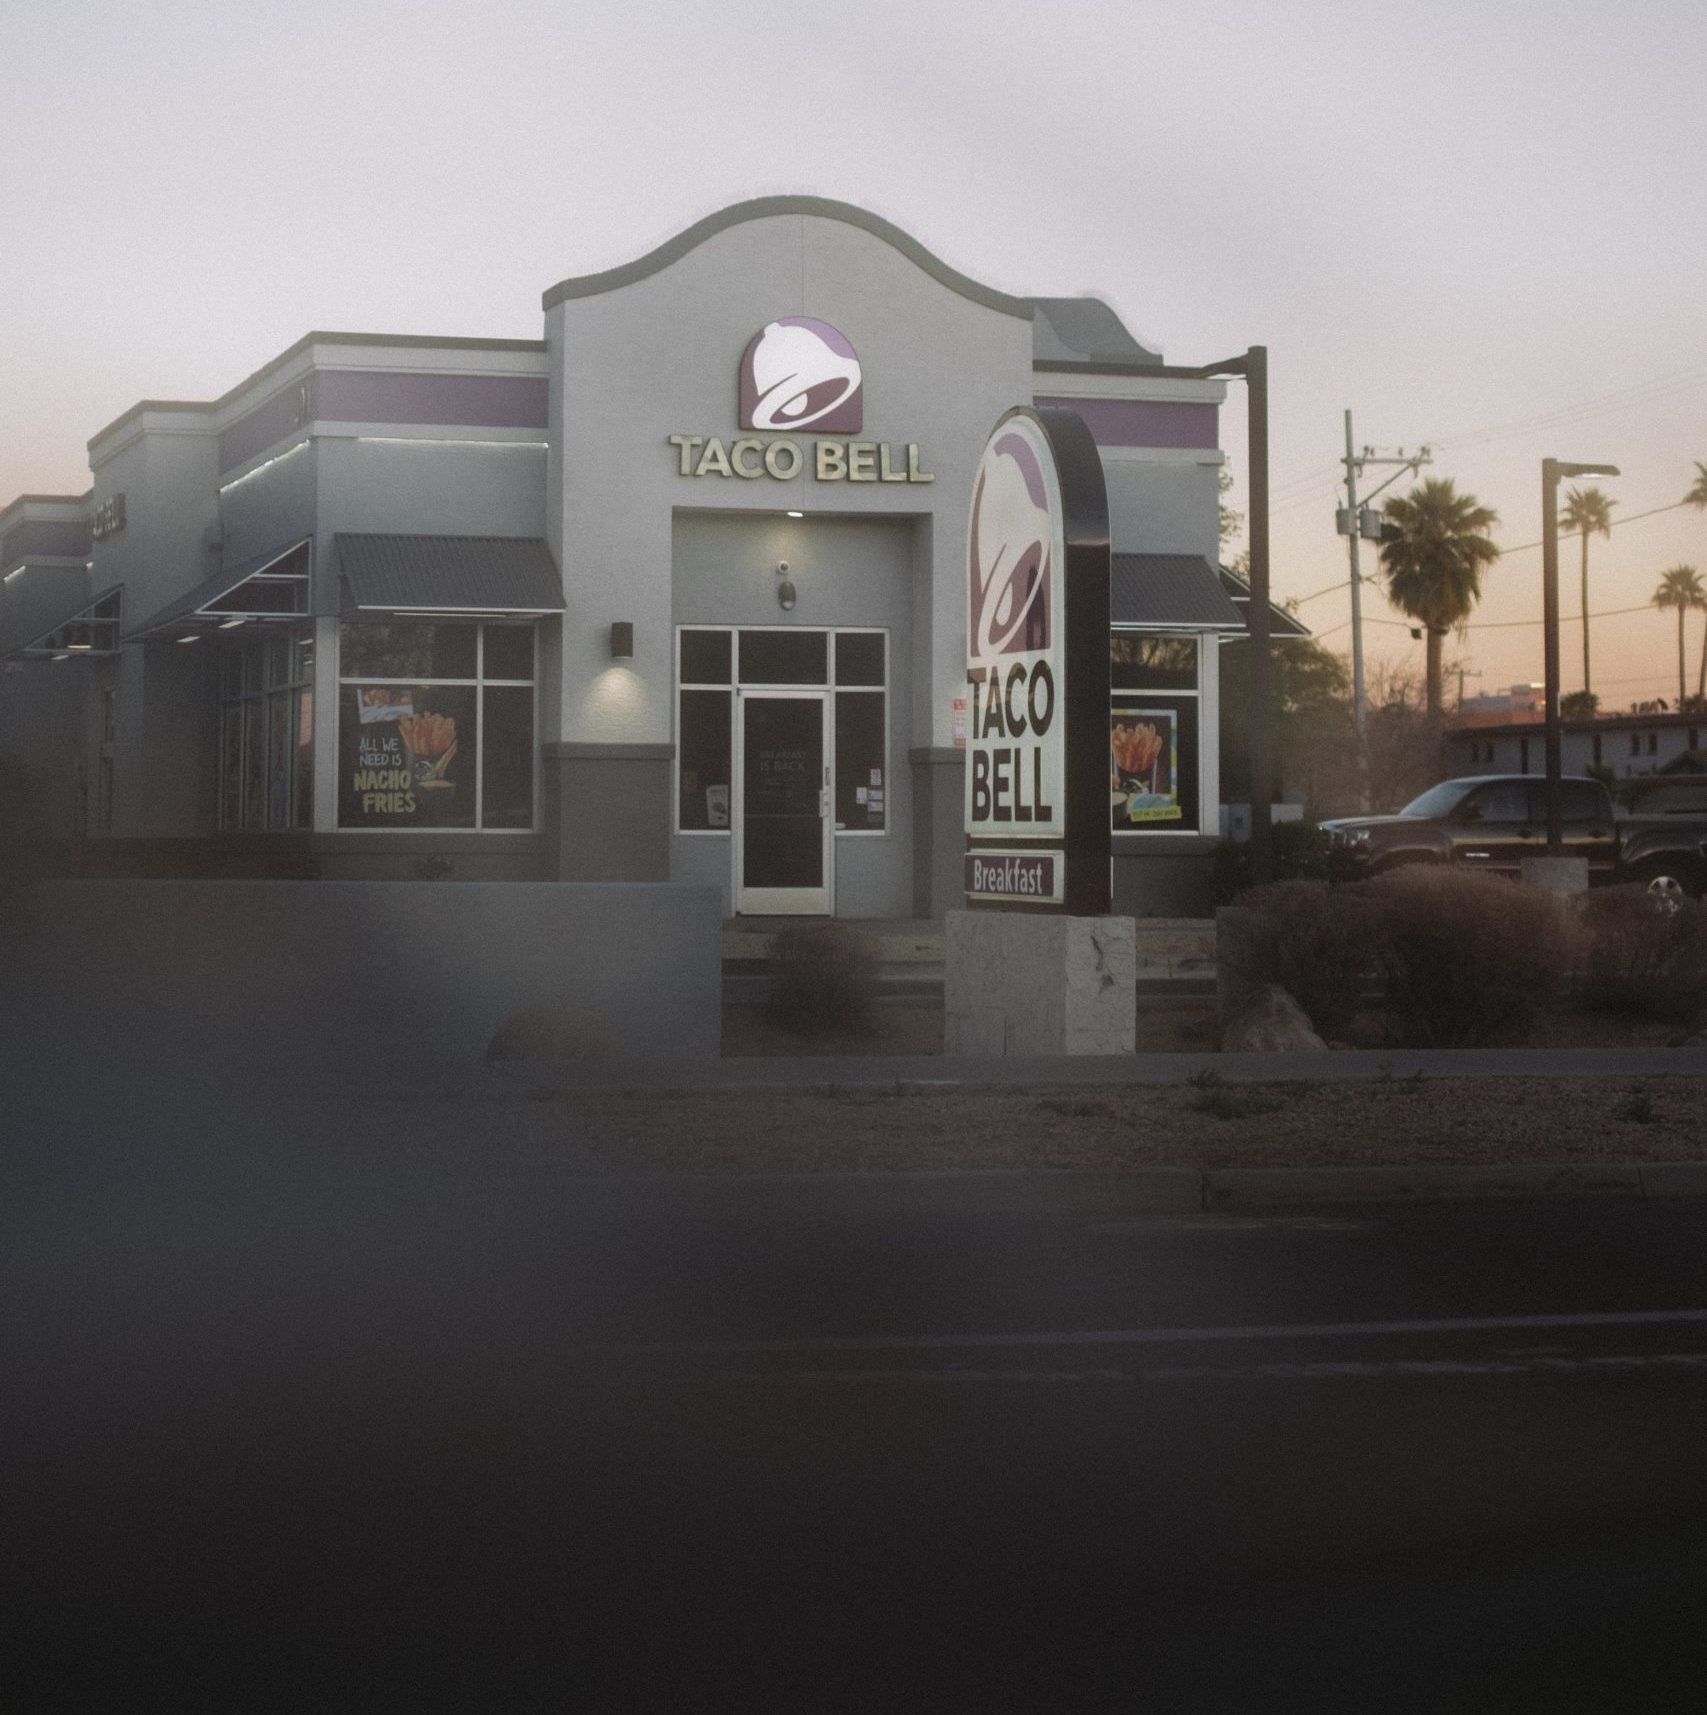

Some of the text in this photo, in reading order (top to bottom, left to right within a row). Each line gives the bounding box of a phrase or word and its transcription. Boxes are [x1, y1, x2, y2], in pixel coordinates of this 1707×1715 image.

[668, 434, 936, 482] TACO BELL
[967, 660, 1054, 739] TACO
[360, 737, 399, 751] ALL WE
[360, 752, 401, 766] NEED IS
[354, 769, 411, 791] NACHO
[972, 747, 1052, 822] BELL
[363, 792, 416, 813] FRIES
[974, 857, 1043, 893] Breakfast
